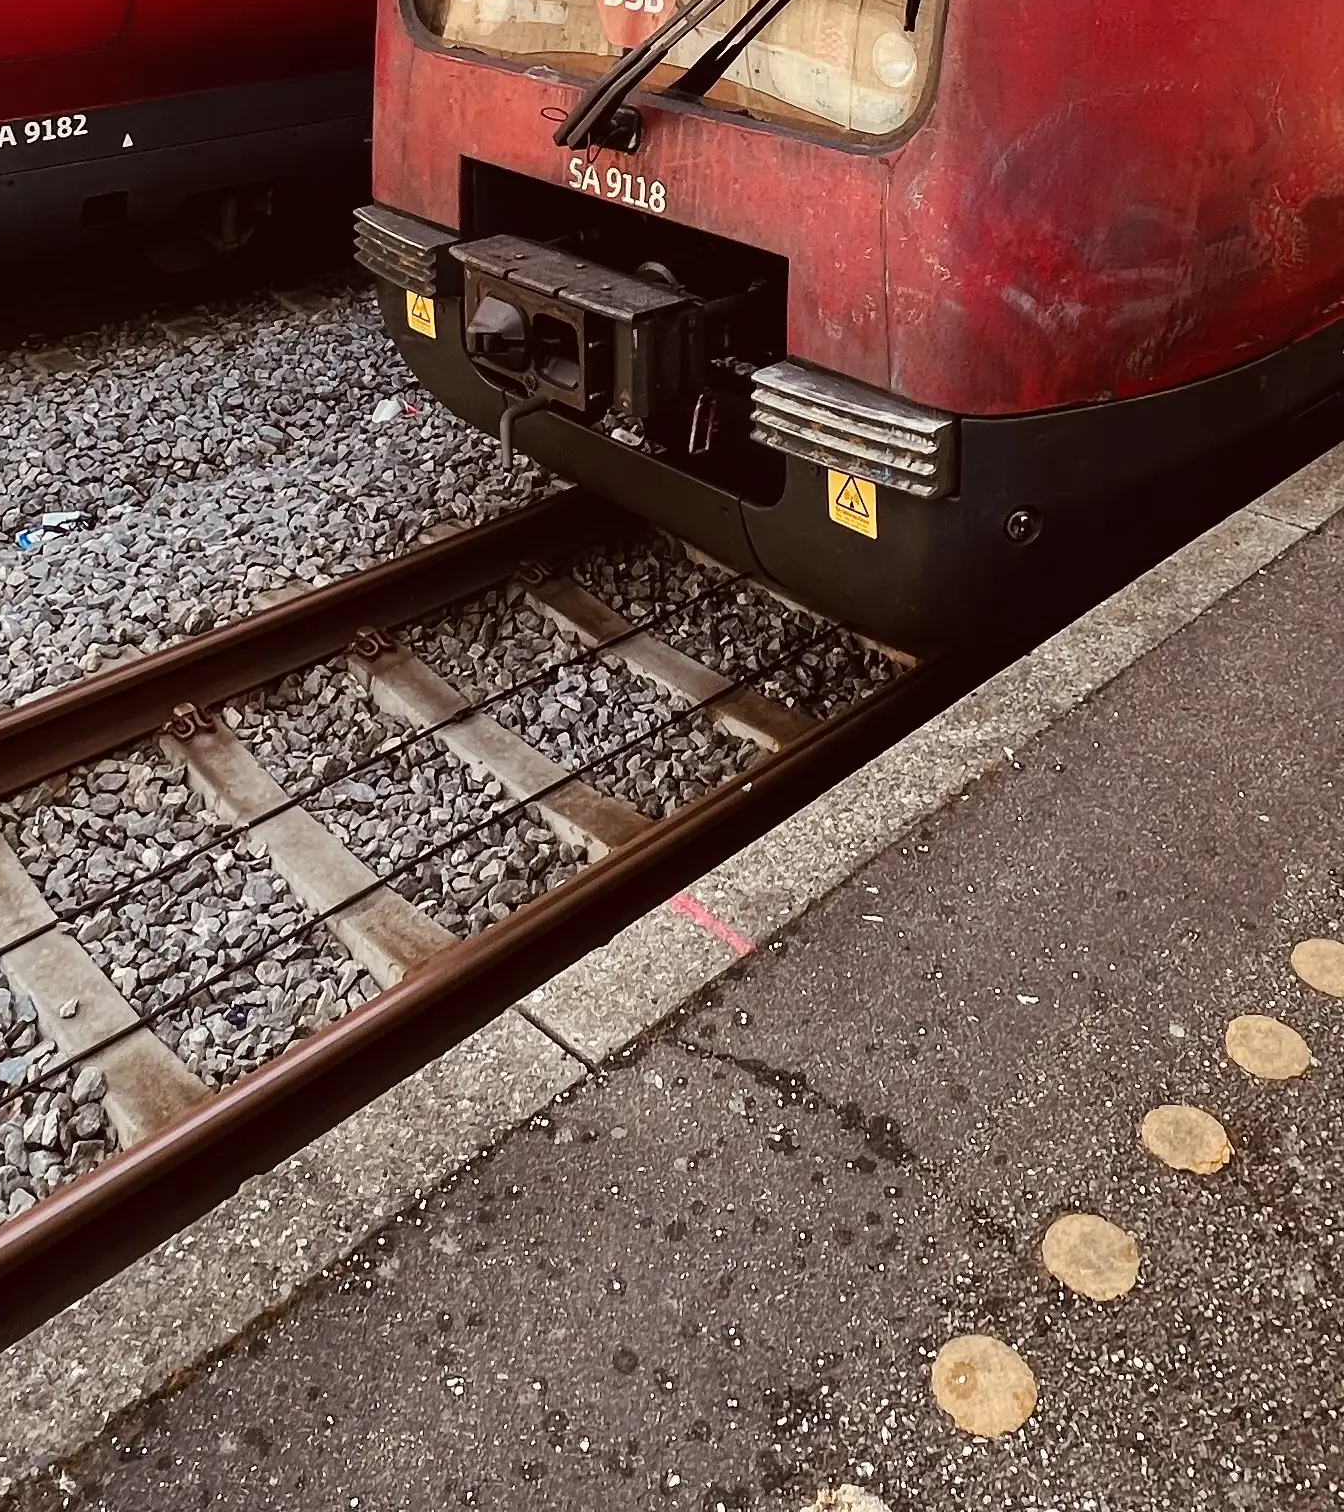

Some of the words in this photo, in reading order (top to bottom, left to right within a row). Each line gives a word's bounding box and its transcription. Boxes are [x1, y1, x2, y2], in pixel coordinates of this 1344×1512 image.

[24, 114, 88, 143] 9182
[568, 157, 601, 195] SA
[606, 167, 666, 213] 9118
